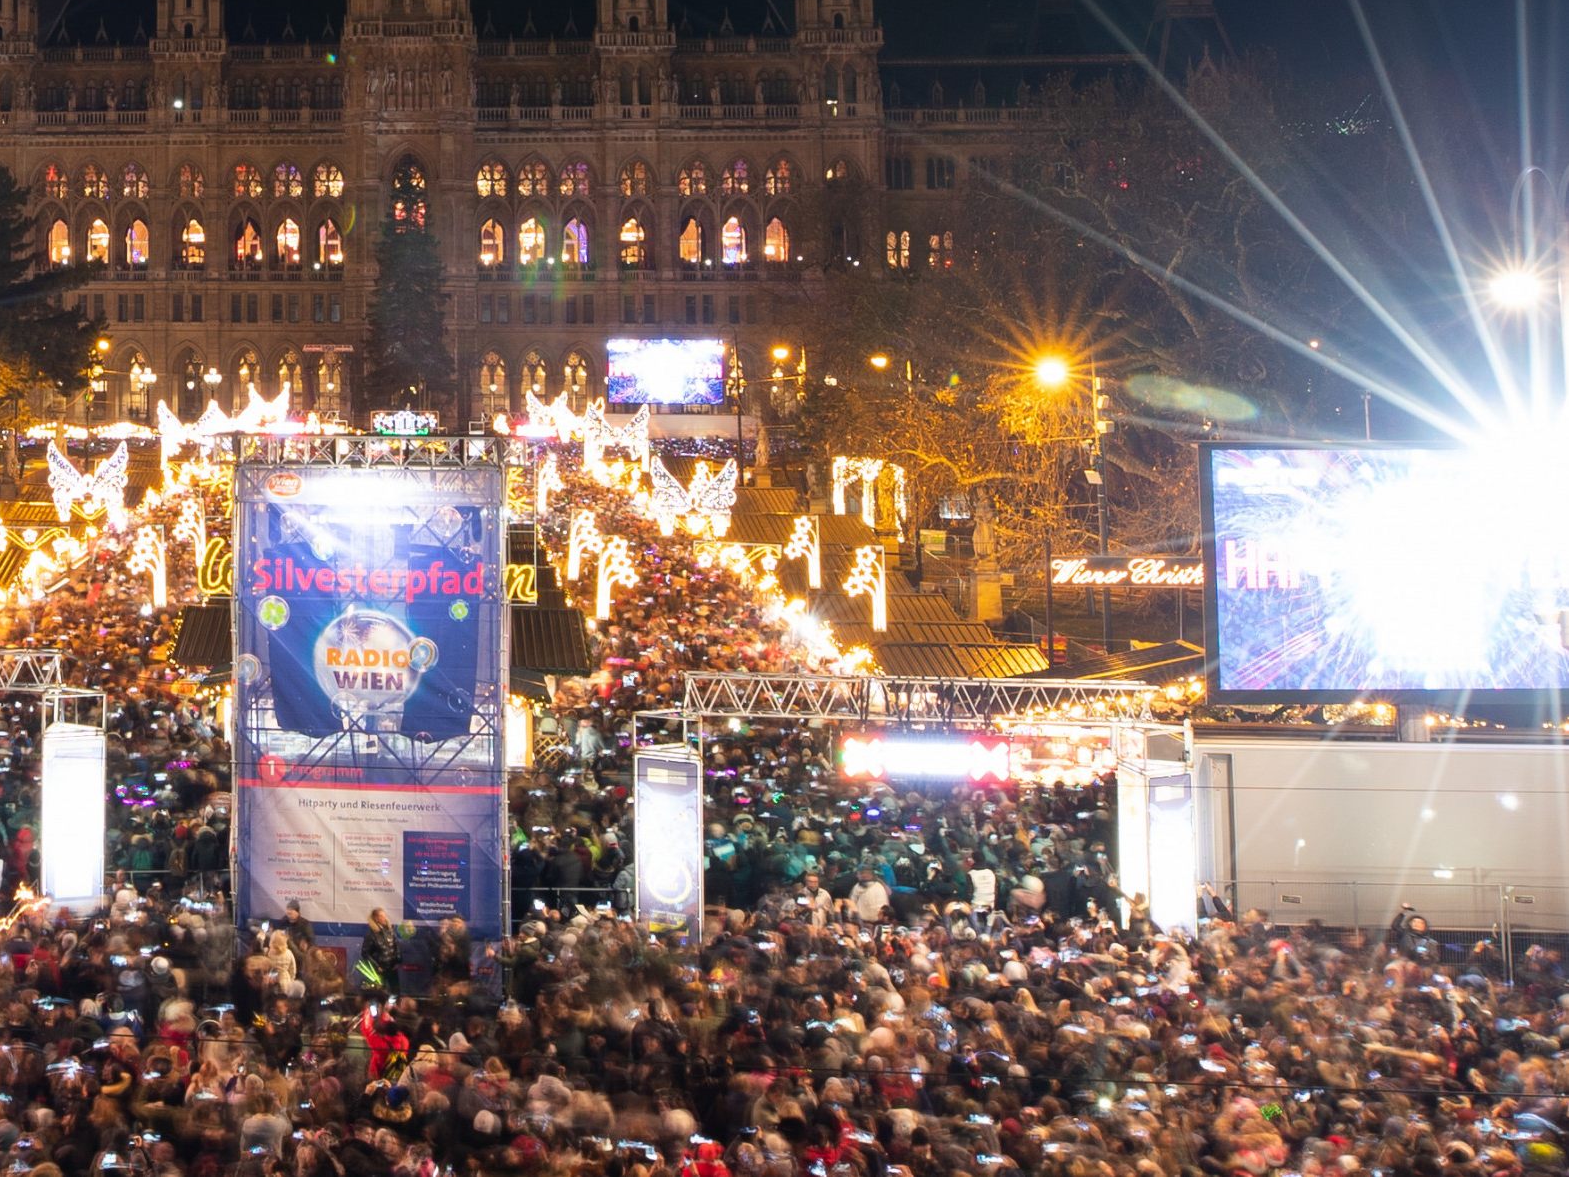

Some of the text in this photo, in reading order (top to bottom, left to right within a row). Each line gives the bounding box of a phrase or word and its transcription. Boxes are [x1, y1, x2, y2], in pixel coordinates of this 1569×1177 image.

[253, 558, 485, 603] Silvesterpfad
[1051, 558, 1128, 584] Wiener
[326, 647, 410, 668] RADIO
[333, 671, 404, 691] WIEN
[267, 760, 363, 780] 1 Programm
[298, 798, 441, 812] Hitparty und Riesenfeuerwerk
